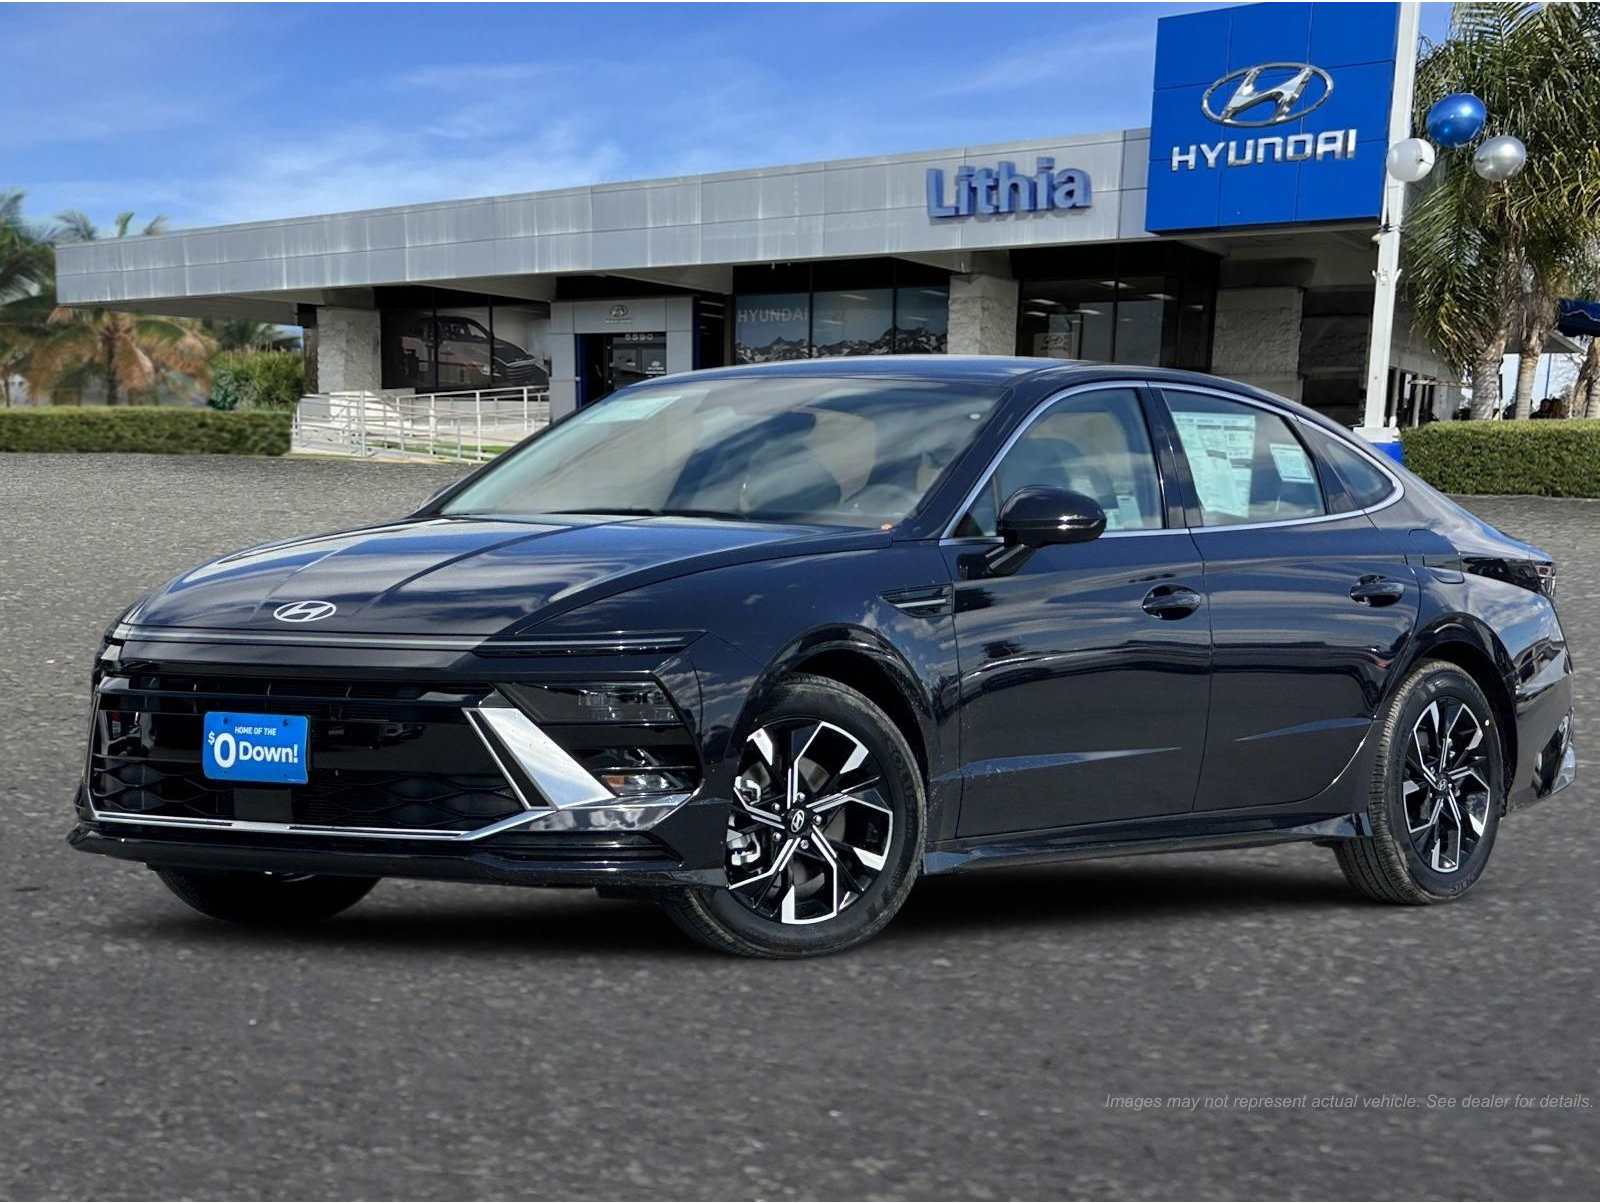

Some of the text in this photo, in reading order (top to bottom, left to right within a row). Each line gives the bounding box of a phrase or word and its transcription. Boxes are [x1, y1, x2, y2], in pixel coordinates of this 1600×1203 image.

[1171, 129, 1357, 171] HYUNDAI
[926, 157, 1092, 217] Lithia
[737, 307, 808, 323] HYUNDAI
[234, 726, 278, 736] HOME OF THE
[238, 741, 299, 764] Down!
